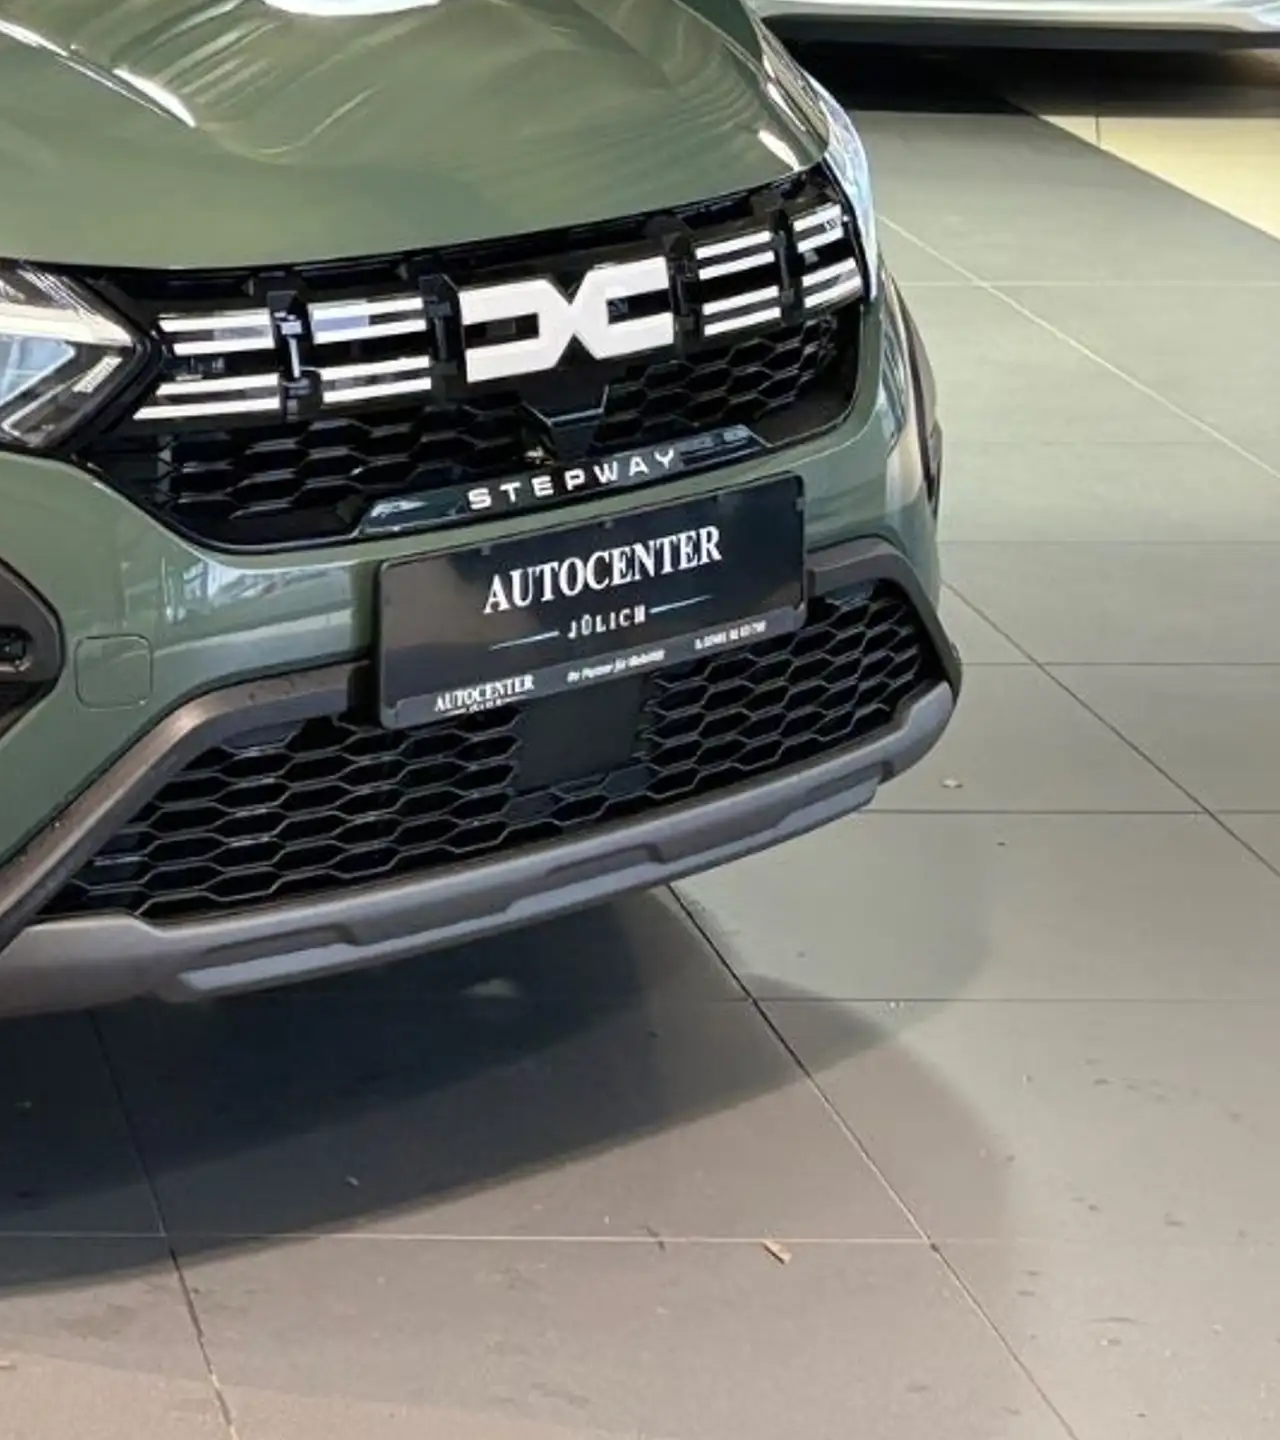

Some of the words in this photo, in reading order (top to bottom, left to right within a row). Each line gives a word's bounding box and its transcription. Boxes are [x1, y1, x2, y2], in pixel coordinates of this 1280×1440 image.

[467, 448, 676, 510] STEPWAY
[483, 525, 723, 614] AUTOCENTER
[566, 604, 647, 640] JÜLICH
